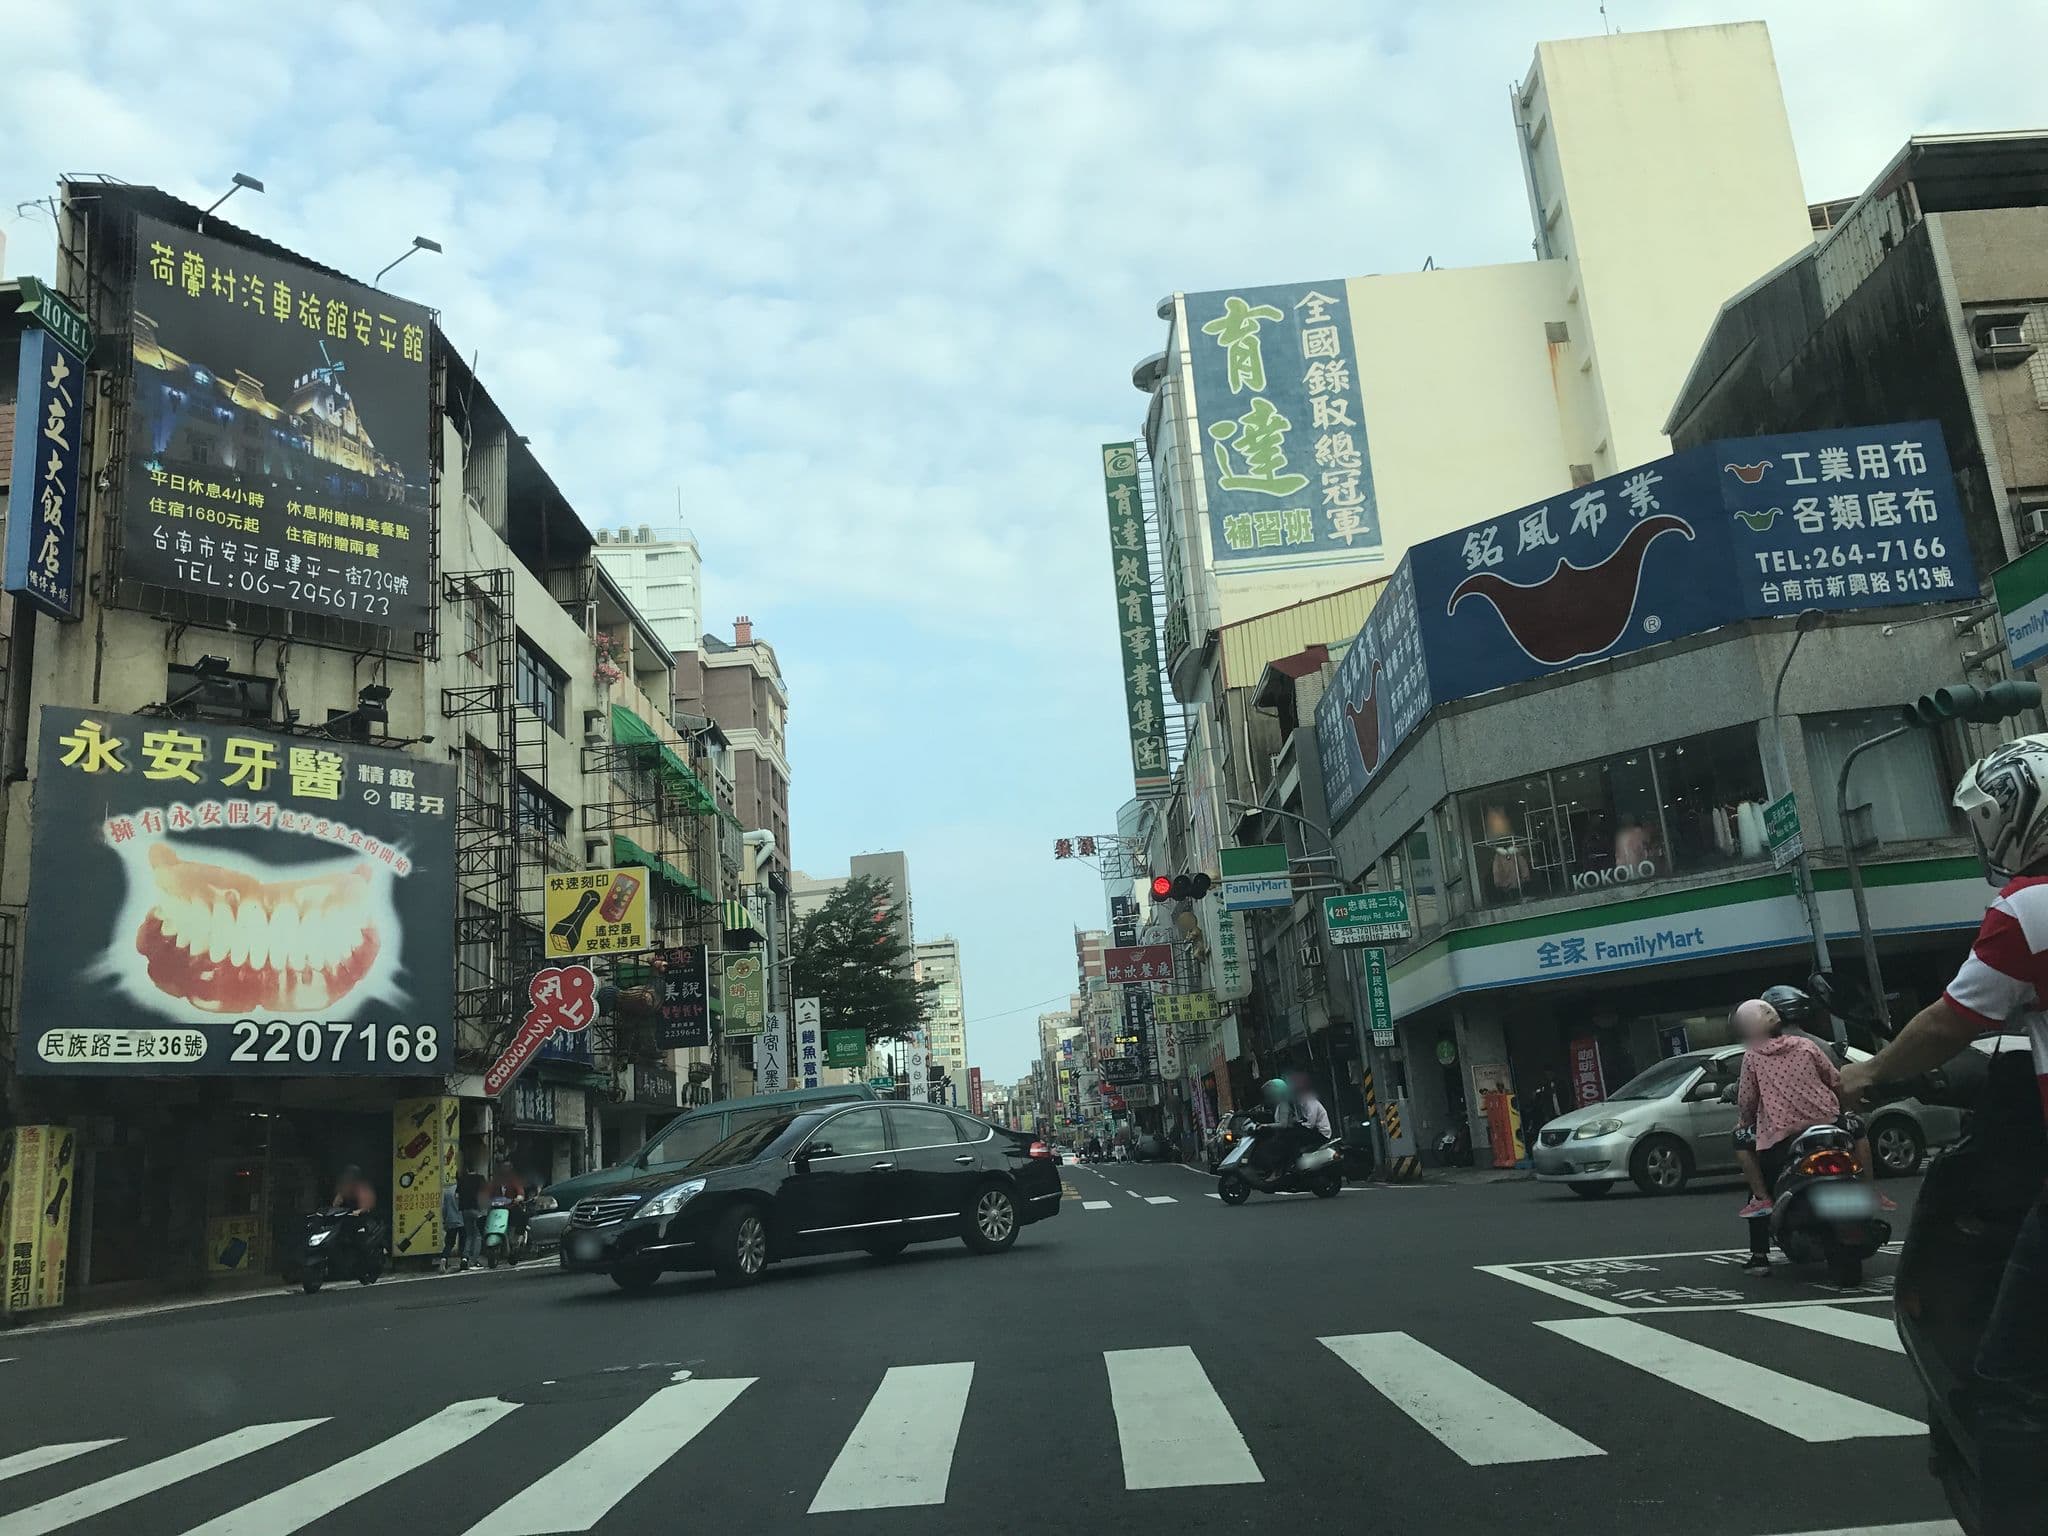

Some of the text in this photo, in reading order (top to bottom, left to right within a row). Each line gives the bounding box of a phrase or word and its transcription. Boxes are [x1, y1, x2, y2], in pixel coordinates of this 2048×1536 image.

[149, 240, 425, 362] 荷蘭村汽車旅館安平館
[41, 294, 89, 351] HOTEL
[1201, 296, 1310, 496] 育達
[1293, 290, 1371, 546] 全國錄取總冠軍
[1781, 440, 1928, 487] 工業用布
[150, 470, 265, 509] 平日休息4小時
[149, 496, 261, 534] 住宿1680元起
[286, 500, 410, 541] 休息附贈精美餐點
[1223, 508, 1314, 549] 補習班
[1460, 470, 1664, 572] 銘風布業
[1791, 487, 1939, 535] 各類底布
[285, 526, 380, 559] 住宿附贈兩餐
[1754, 537, 1947, 575] TEL:264-7166
[1109, 483, 1167, 773] 育達教育事業集團
[59, 719, 344, 801] 永安牙醫
[357, 763, 416, 790] 精緻
[550, 874, 609, 891] 快速刻印
[1225, 880, 1288, 894] FamilyMart
[1571, 860, 1656, 891] KOKOLO
[1334, 897, 1399, 917] 213 忠義路二段
[595, 923, 632, 937] 遙控器
[1536, 927, 1705, 970] 全家 FamilyMart
[1108, 962, 1171, 980] 欣欣餐廳
[1372, 975, 1387, 1028] 民族路二段
[43, 1034, 203, 1058] 民族路三段36號
[230, 1021, 439, 1063] 2207168
[487, 1013, 553, 1088] 2213388
[10, 1242, 33, 1308] 電腦刻印
